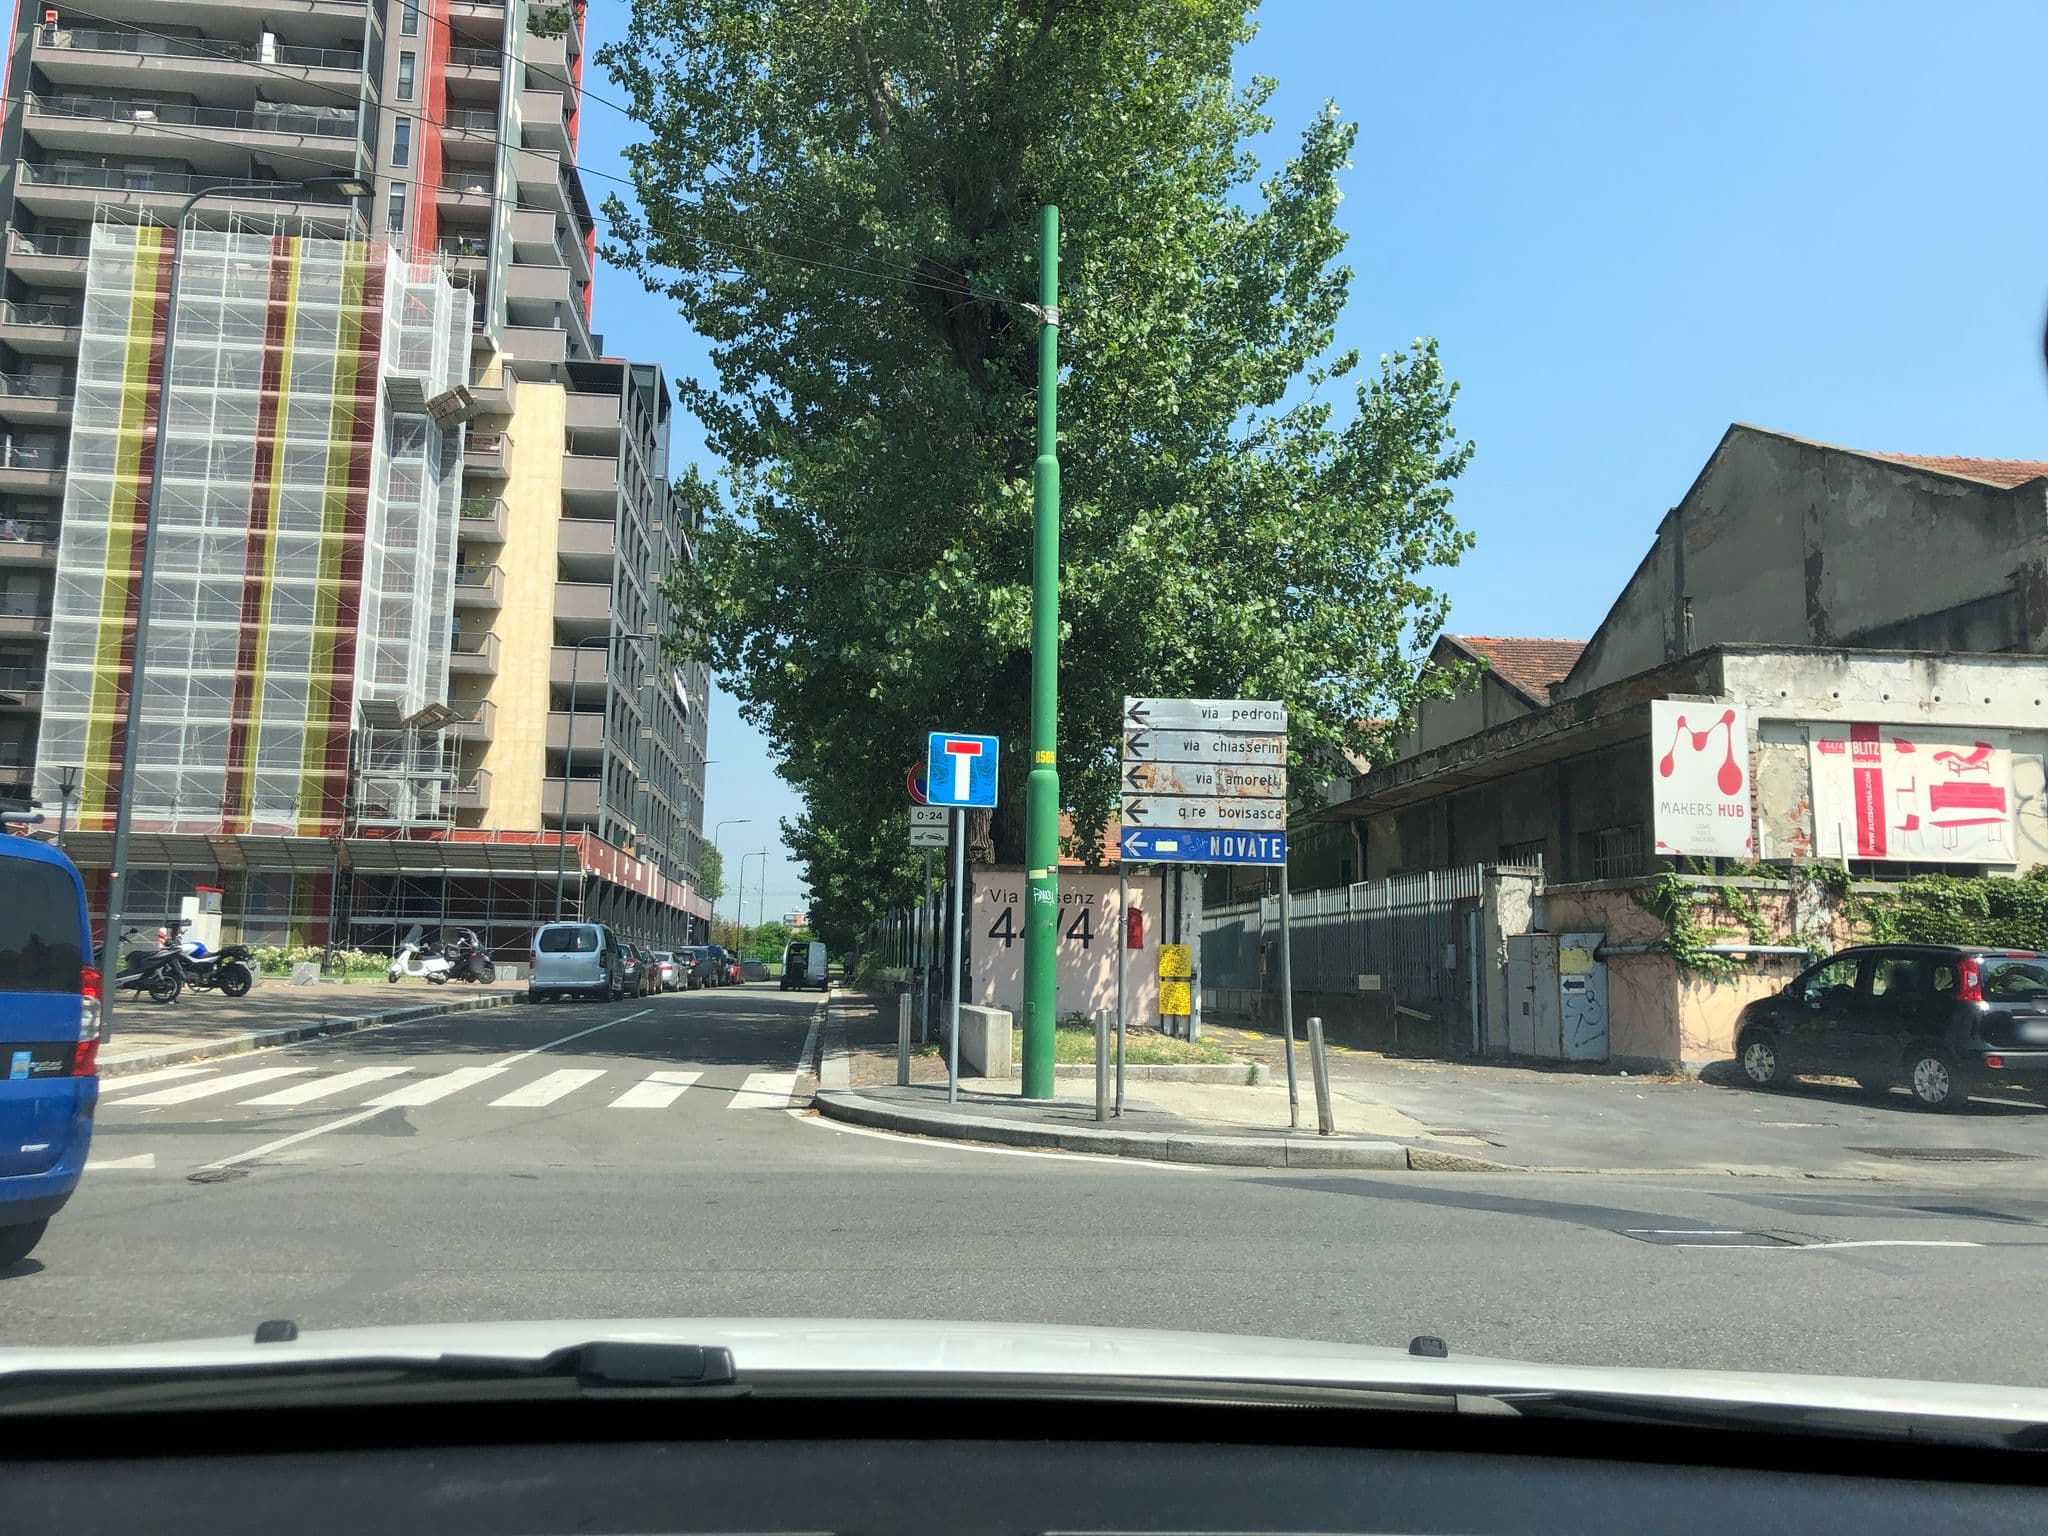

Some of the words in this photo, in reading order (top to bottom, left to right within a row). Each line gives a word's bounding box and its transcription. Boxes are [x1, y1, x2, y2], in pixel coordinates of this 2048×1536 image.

[1201, 708, 1219, 719] via
[1232, 708, 1283, 722] pedroni
[1183, 740, 1200, 751] via
[1212, 740, 1282, 754] chiasserini
[1852, 741, 1880, 755] BLITZ
[1196, 773, 1213, 785] via
[917, 811, 943, 820] 0-24
[1219, 806, 1282, 820] bovisasca
[1660, 801, 1713, 816] MAKERS
[1718, 803, 1745, 818] HUB
[1210, 836, 1281, 858] NOVATE
[990, 888, 1018, 903] Via
[988, 906, 1095, 949] 4/4
